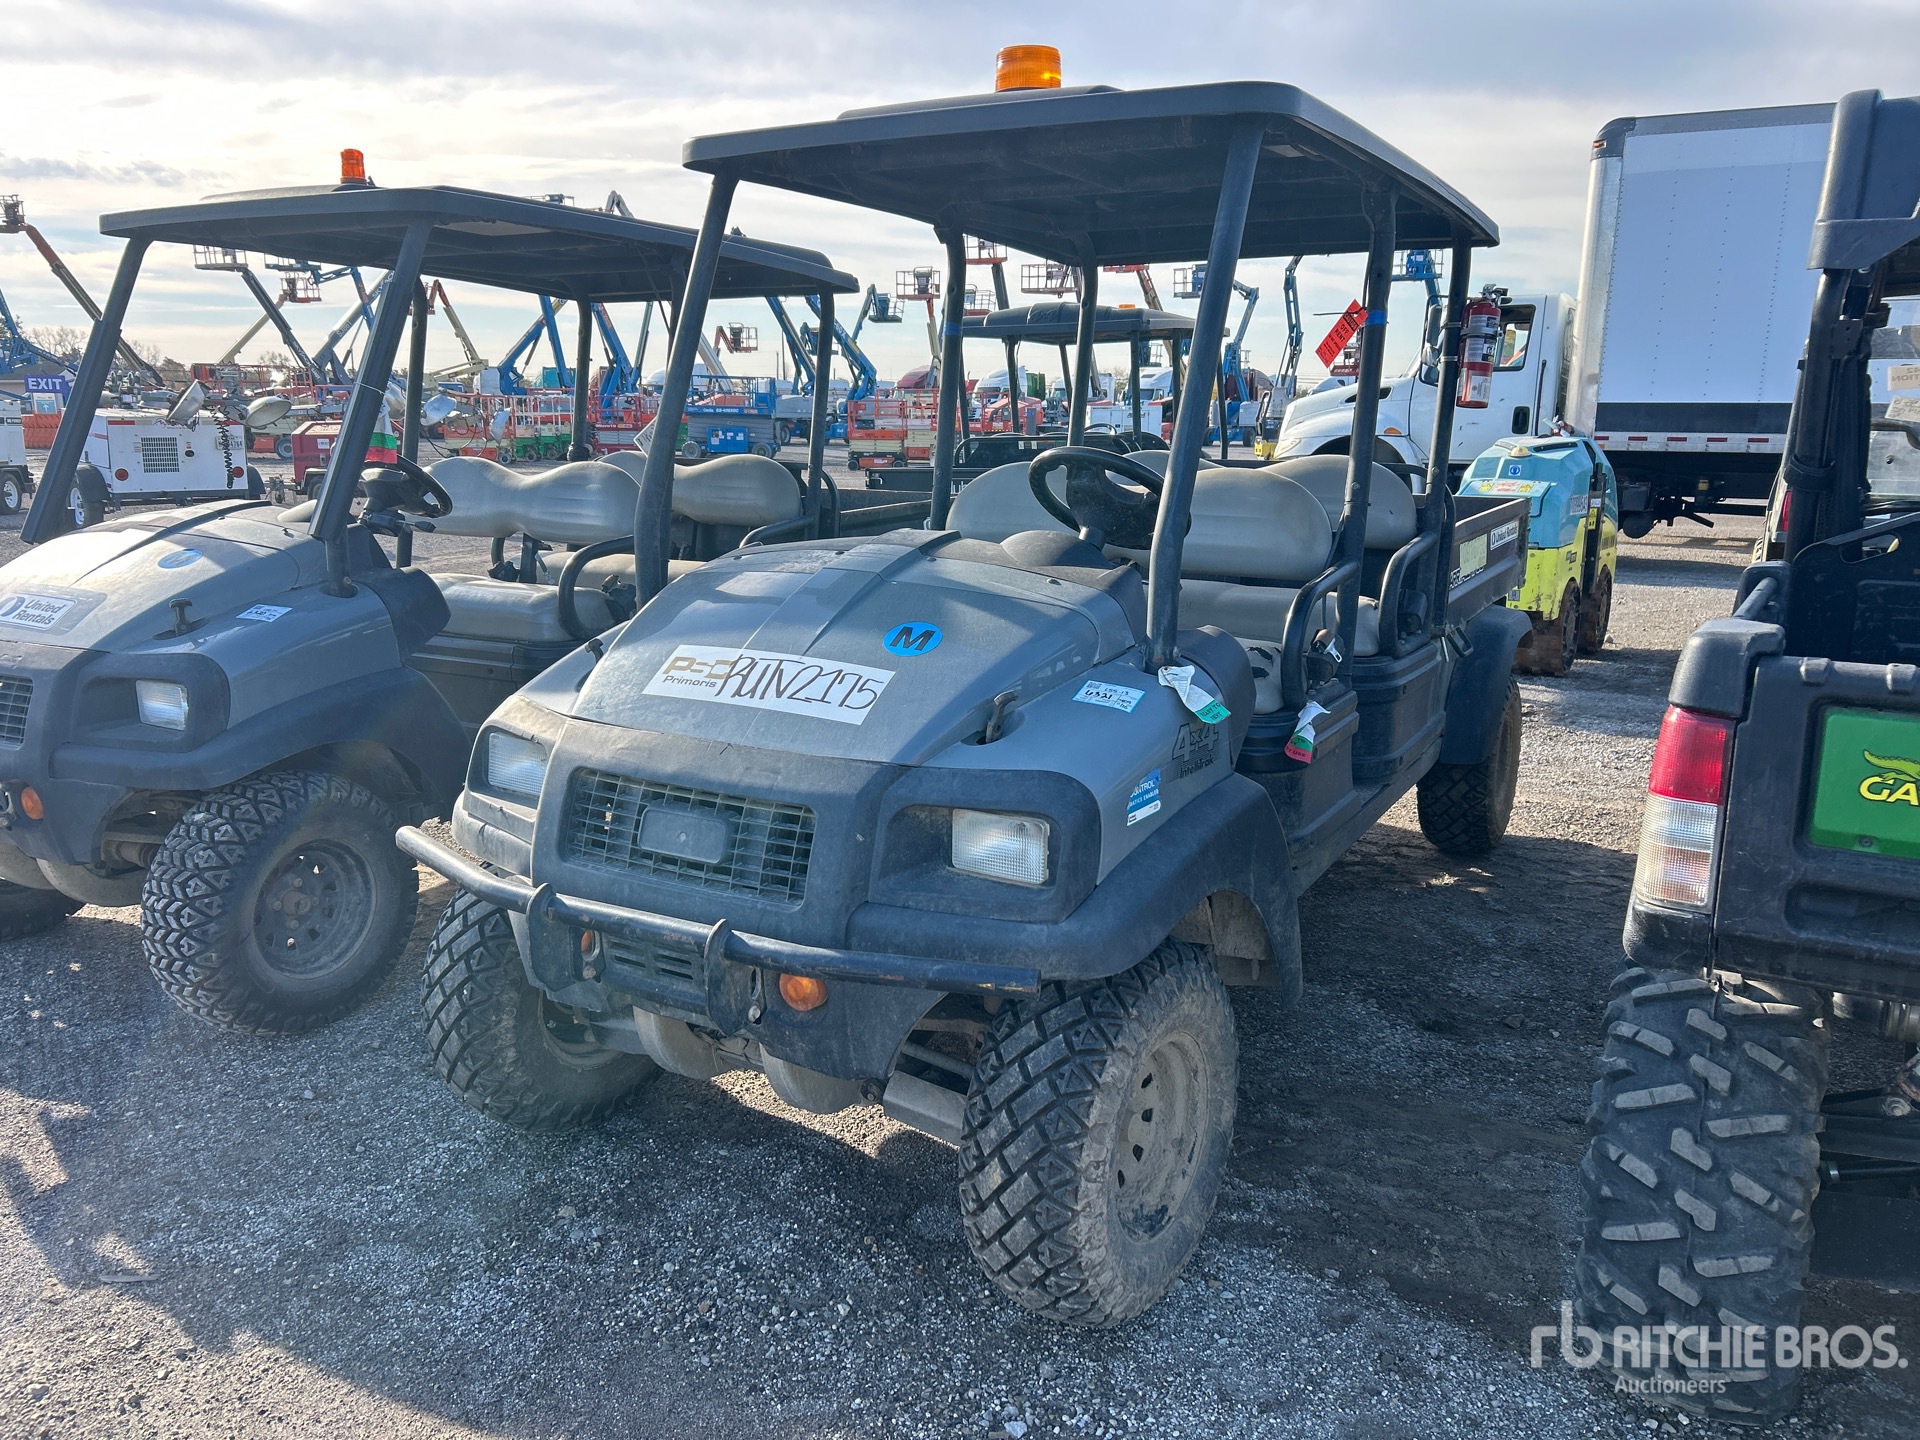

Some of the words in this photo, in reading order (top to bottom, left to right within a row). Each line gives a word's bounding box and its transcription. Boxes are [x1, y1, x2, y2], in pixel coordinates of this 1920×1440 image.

[28, 377, 62, 390] EXIT
[1495, 529, 1507, 543] United
[25, 599, 66, 614] United
[12, 609, 55, 625] Rentals
[889, 626, 935, 651] M
[662, 675, 717, 688] Primoris
[1171, 722, 1220, 764] 4x4
[1179, 754, 1215, 779] IntelliTrak
